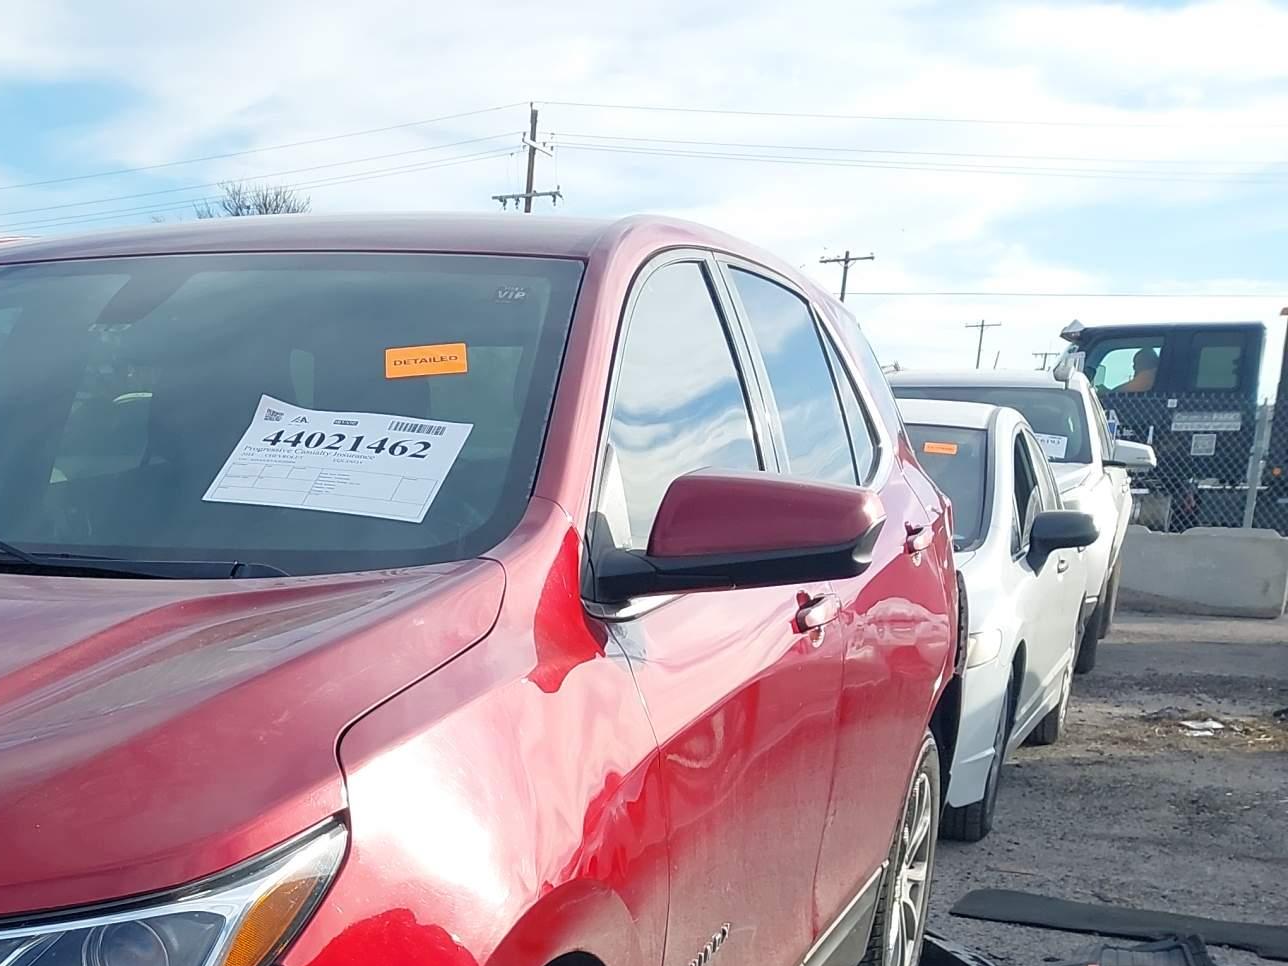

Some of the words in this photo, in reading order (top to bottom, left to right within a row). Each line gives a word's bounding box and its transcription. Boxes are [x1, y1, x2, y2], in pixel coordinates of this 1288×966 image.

[393, 355, 458, 366] DETAILED
[263, 430, 432, 459] 44021462
[244, 445, 293, 453] Progressive
[294, 448, 330, 456] Casualty
[331, 451, 376, 460] Insurance
